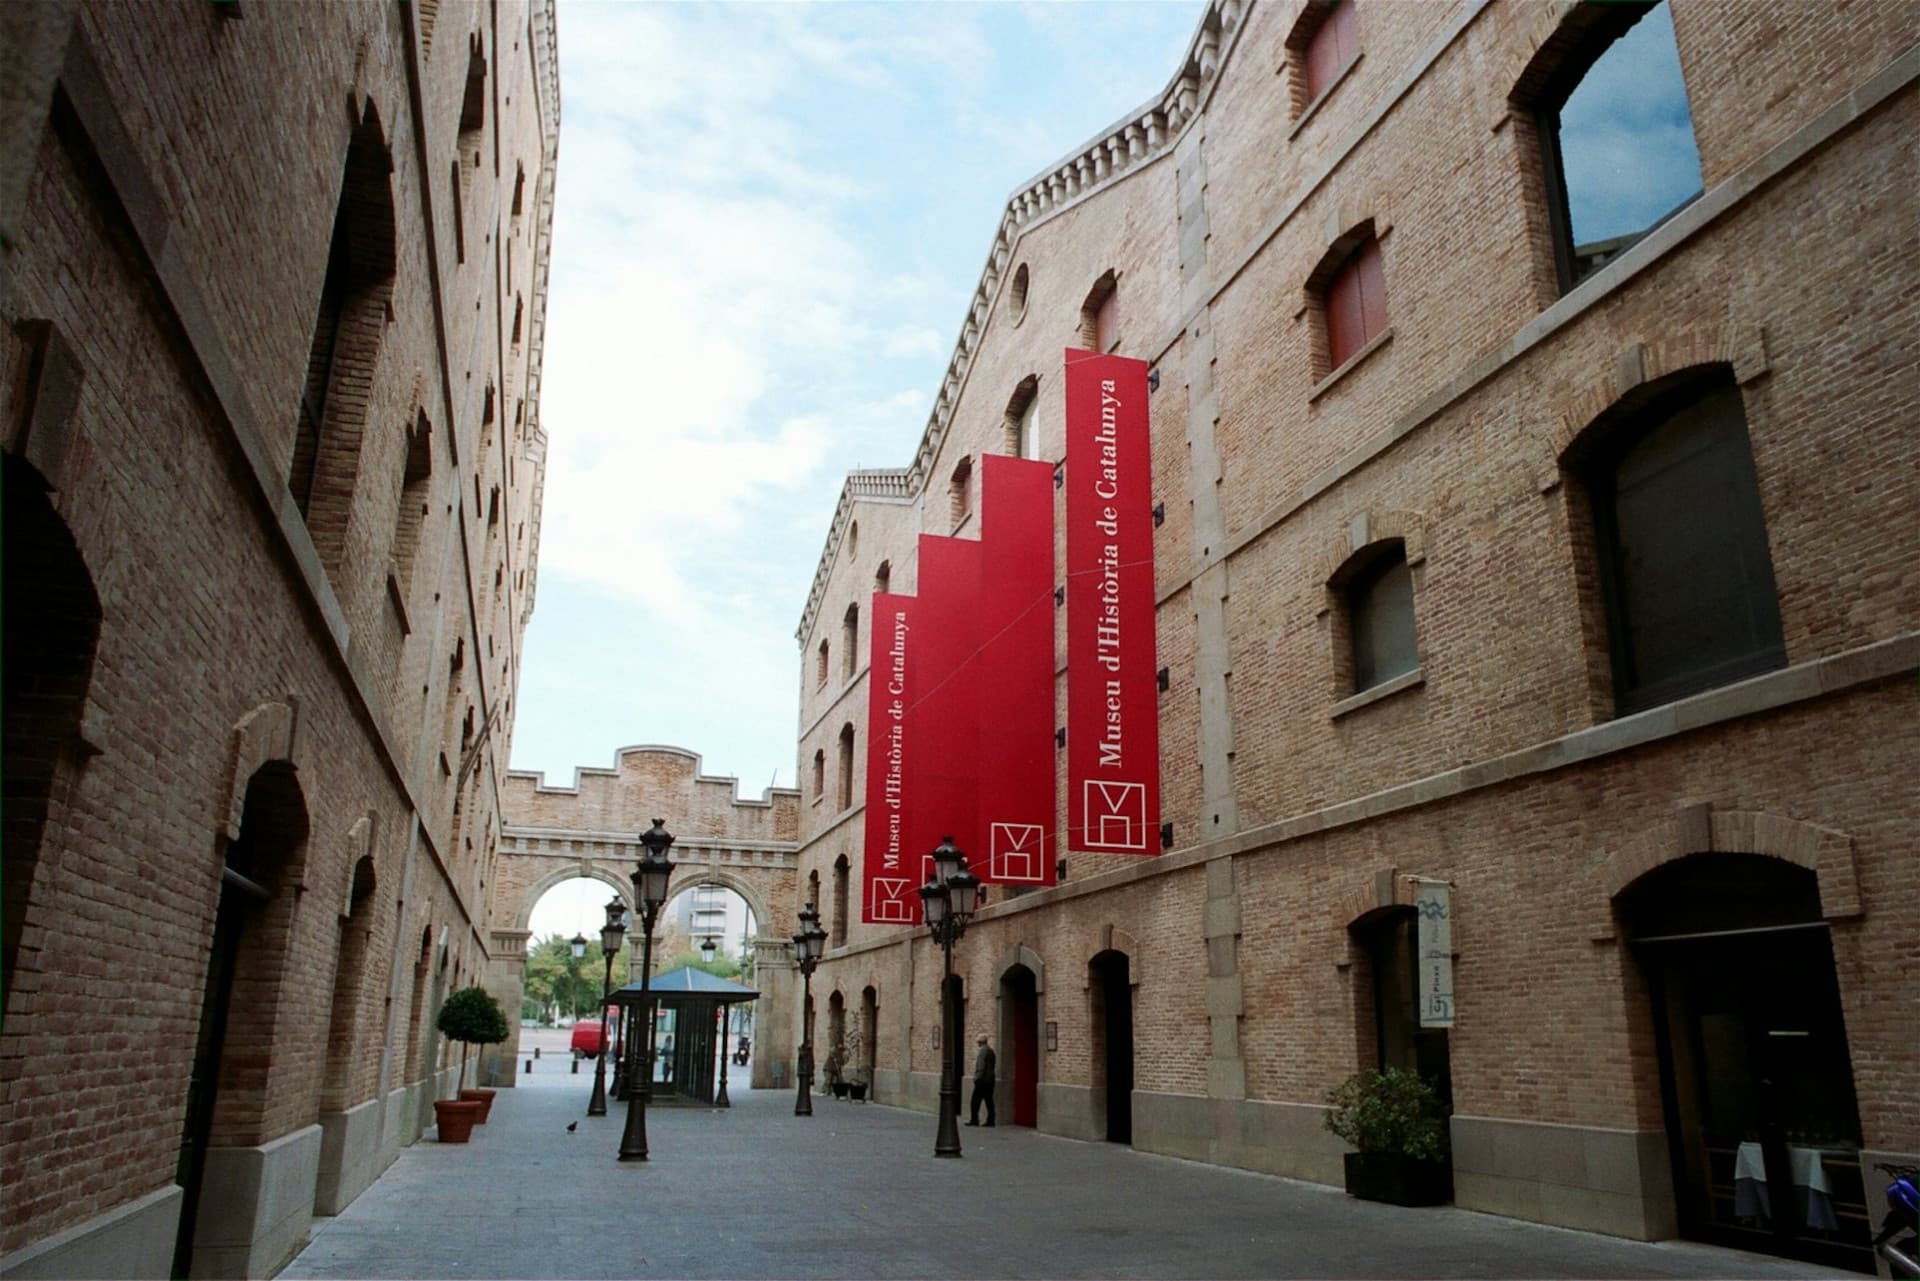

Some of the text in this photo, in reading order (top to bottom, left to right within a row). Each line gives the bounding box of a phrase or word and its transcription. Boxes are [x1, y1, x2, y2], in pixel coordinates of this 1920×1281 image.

[1094, 379, 1122, 767] Museu d'Història de Catalunya
[883, 611, 910, 869] Museu d'Història de Catalunya
